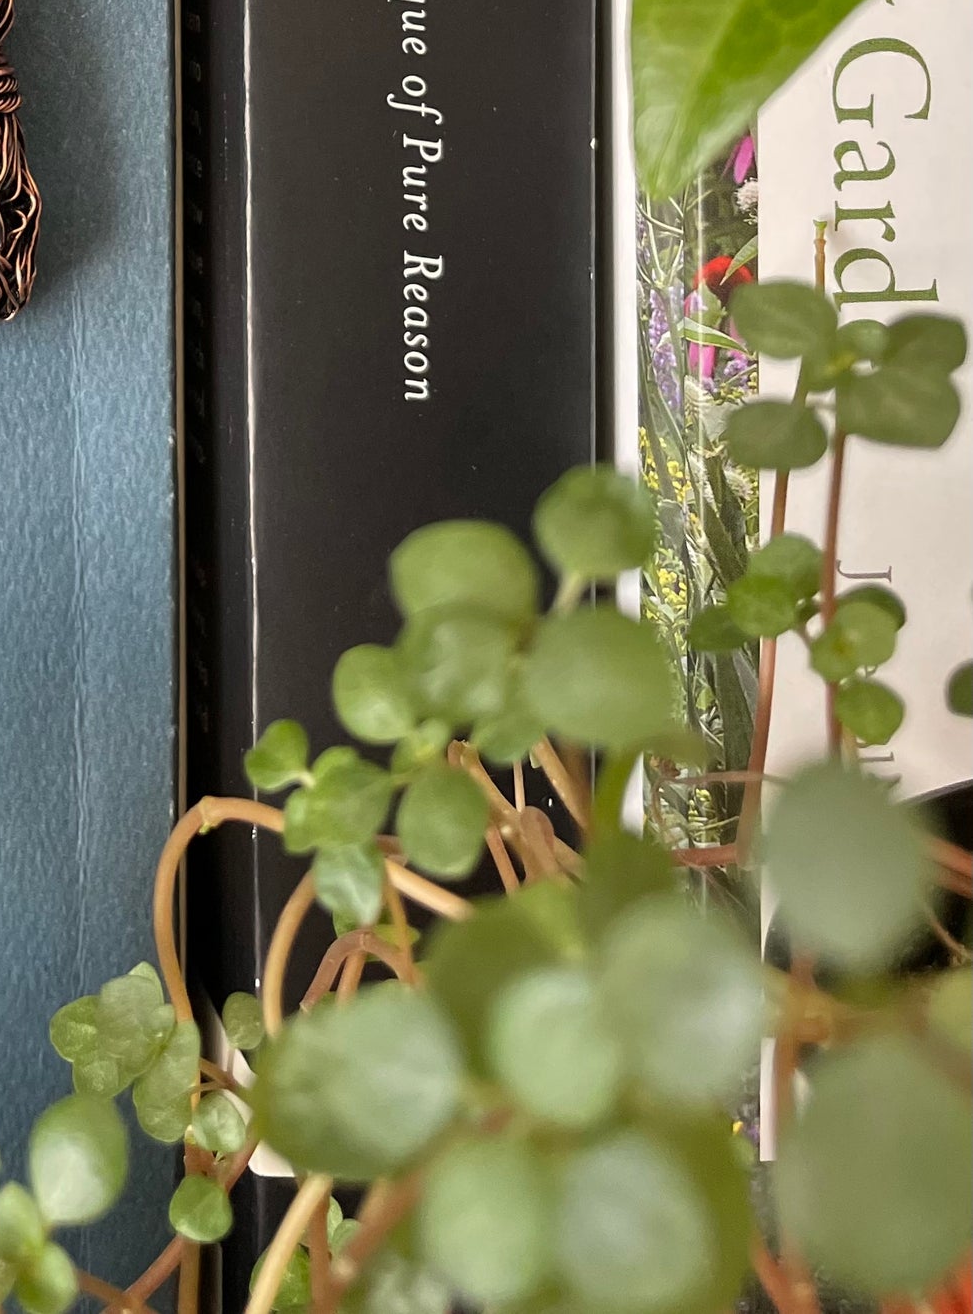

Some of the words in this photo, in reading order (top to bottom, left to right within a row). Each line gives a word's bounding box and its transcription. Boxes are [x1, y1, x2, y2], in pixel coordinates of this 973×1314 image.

[386, 75, 443, 125] of
[402, 133, 443, 232] Pure
[832, 36, 940, 313] Gard
[403, 249, 443, 402] Reason
